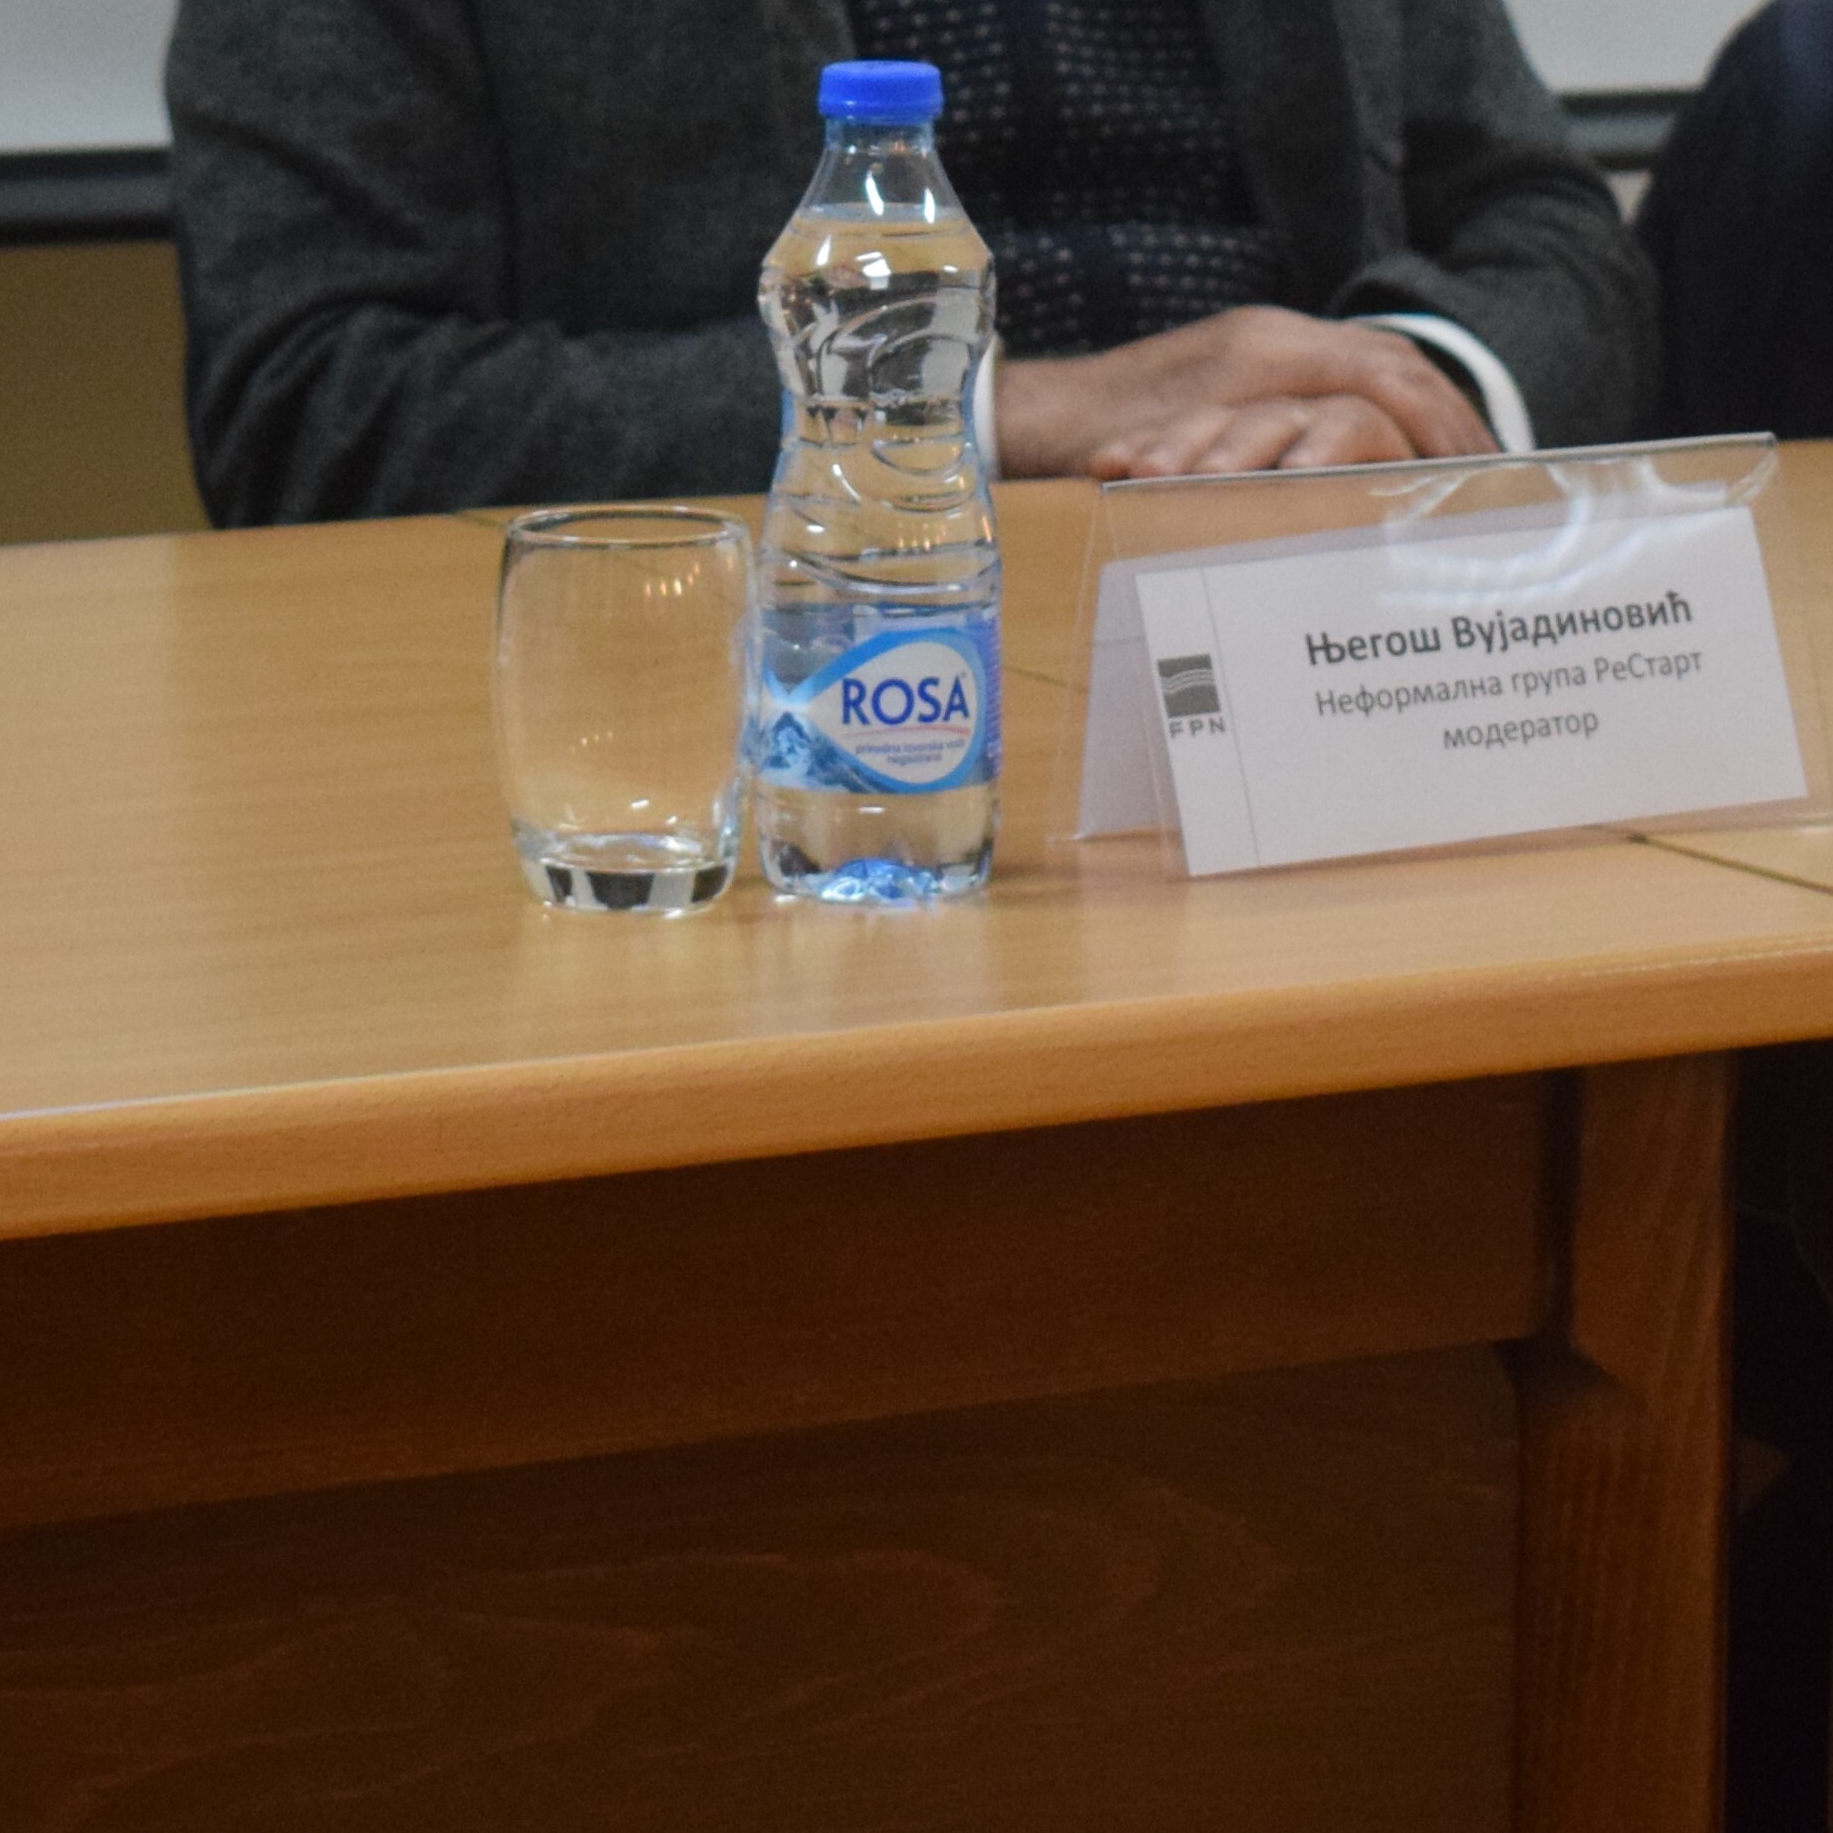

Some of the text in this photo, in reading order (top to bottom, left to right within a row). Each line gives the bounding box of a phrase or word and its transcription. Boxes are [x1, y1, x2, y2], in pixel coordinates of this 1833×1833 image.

[1305, 589, 1693, 667] Његош Вујадиновић
[841, 675, 971, 726] ROSA
[1315, 651, 1703, 718] Неформална група РеСтарт
[1169, 717, 1227, 740] FPN
[1442, 711, 1599, 751] модератор
